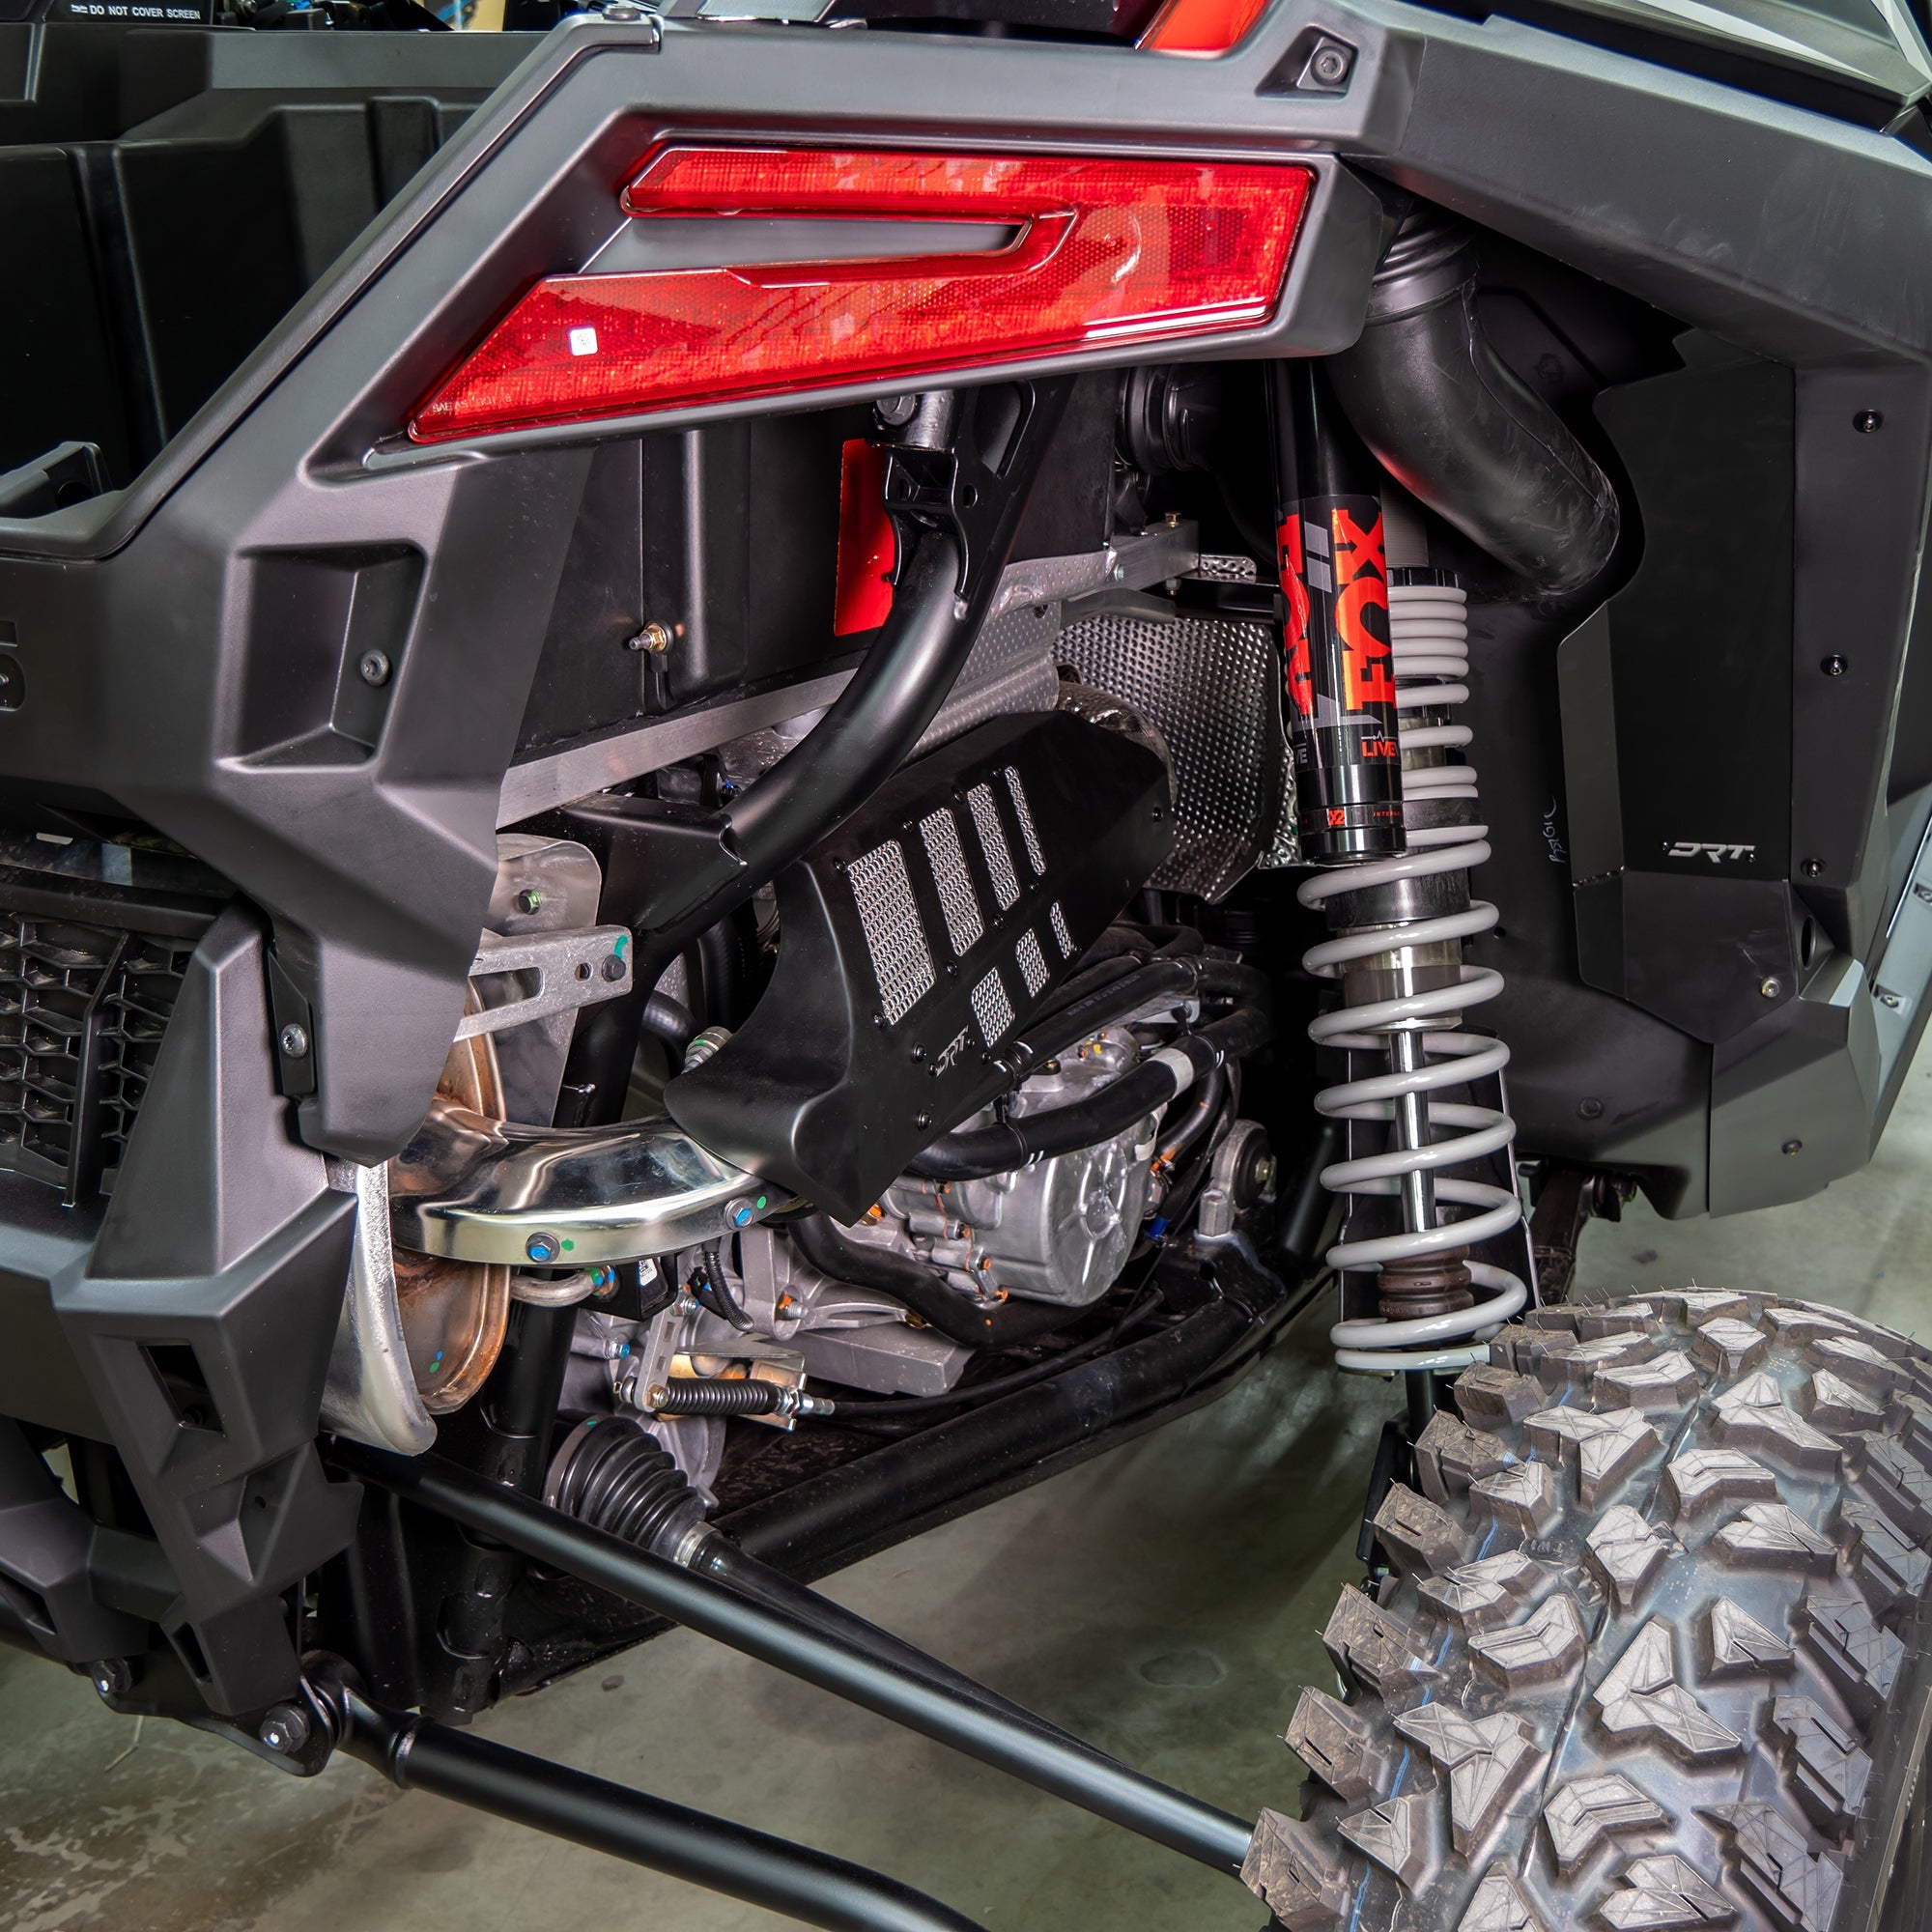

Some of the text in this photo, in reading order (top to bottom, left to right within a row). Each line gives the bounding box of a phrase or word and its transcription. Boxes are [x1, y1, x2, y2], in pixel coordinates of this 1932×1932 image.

[89, 5, 201, 19] DO NOT COVER SCREEN
[432, 402, 452, 413] SAE
[1331, 506, 1397, 711] FOX
[1361, 740, 1397, 757] LIVE
[1327, 809, 1347, 826] X2
[1668, 841, 1756, 864] DRT
